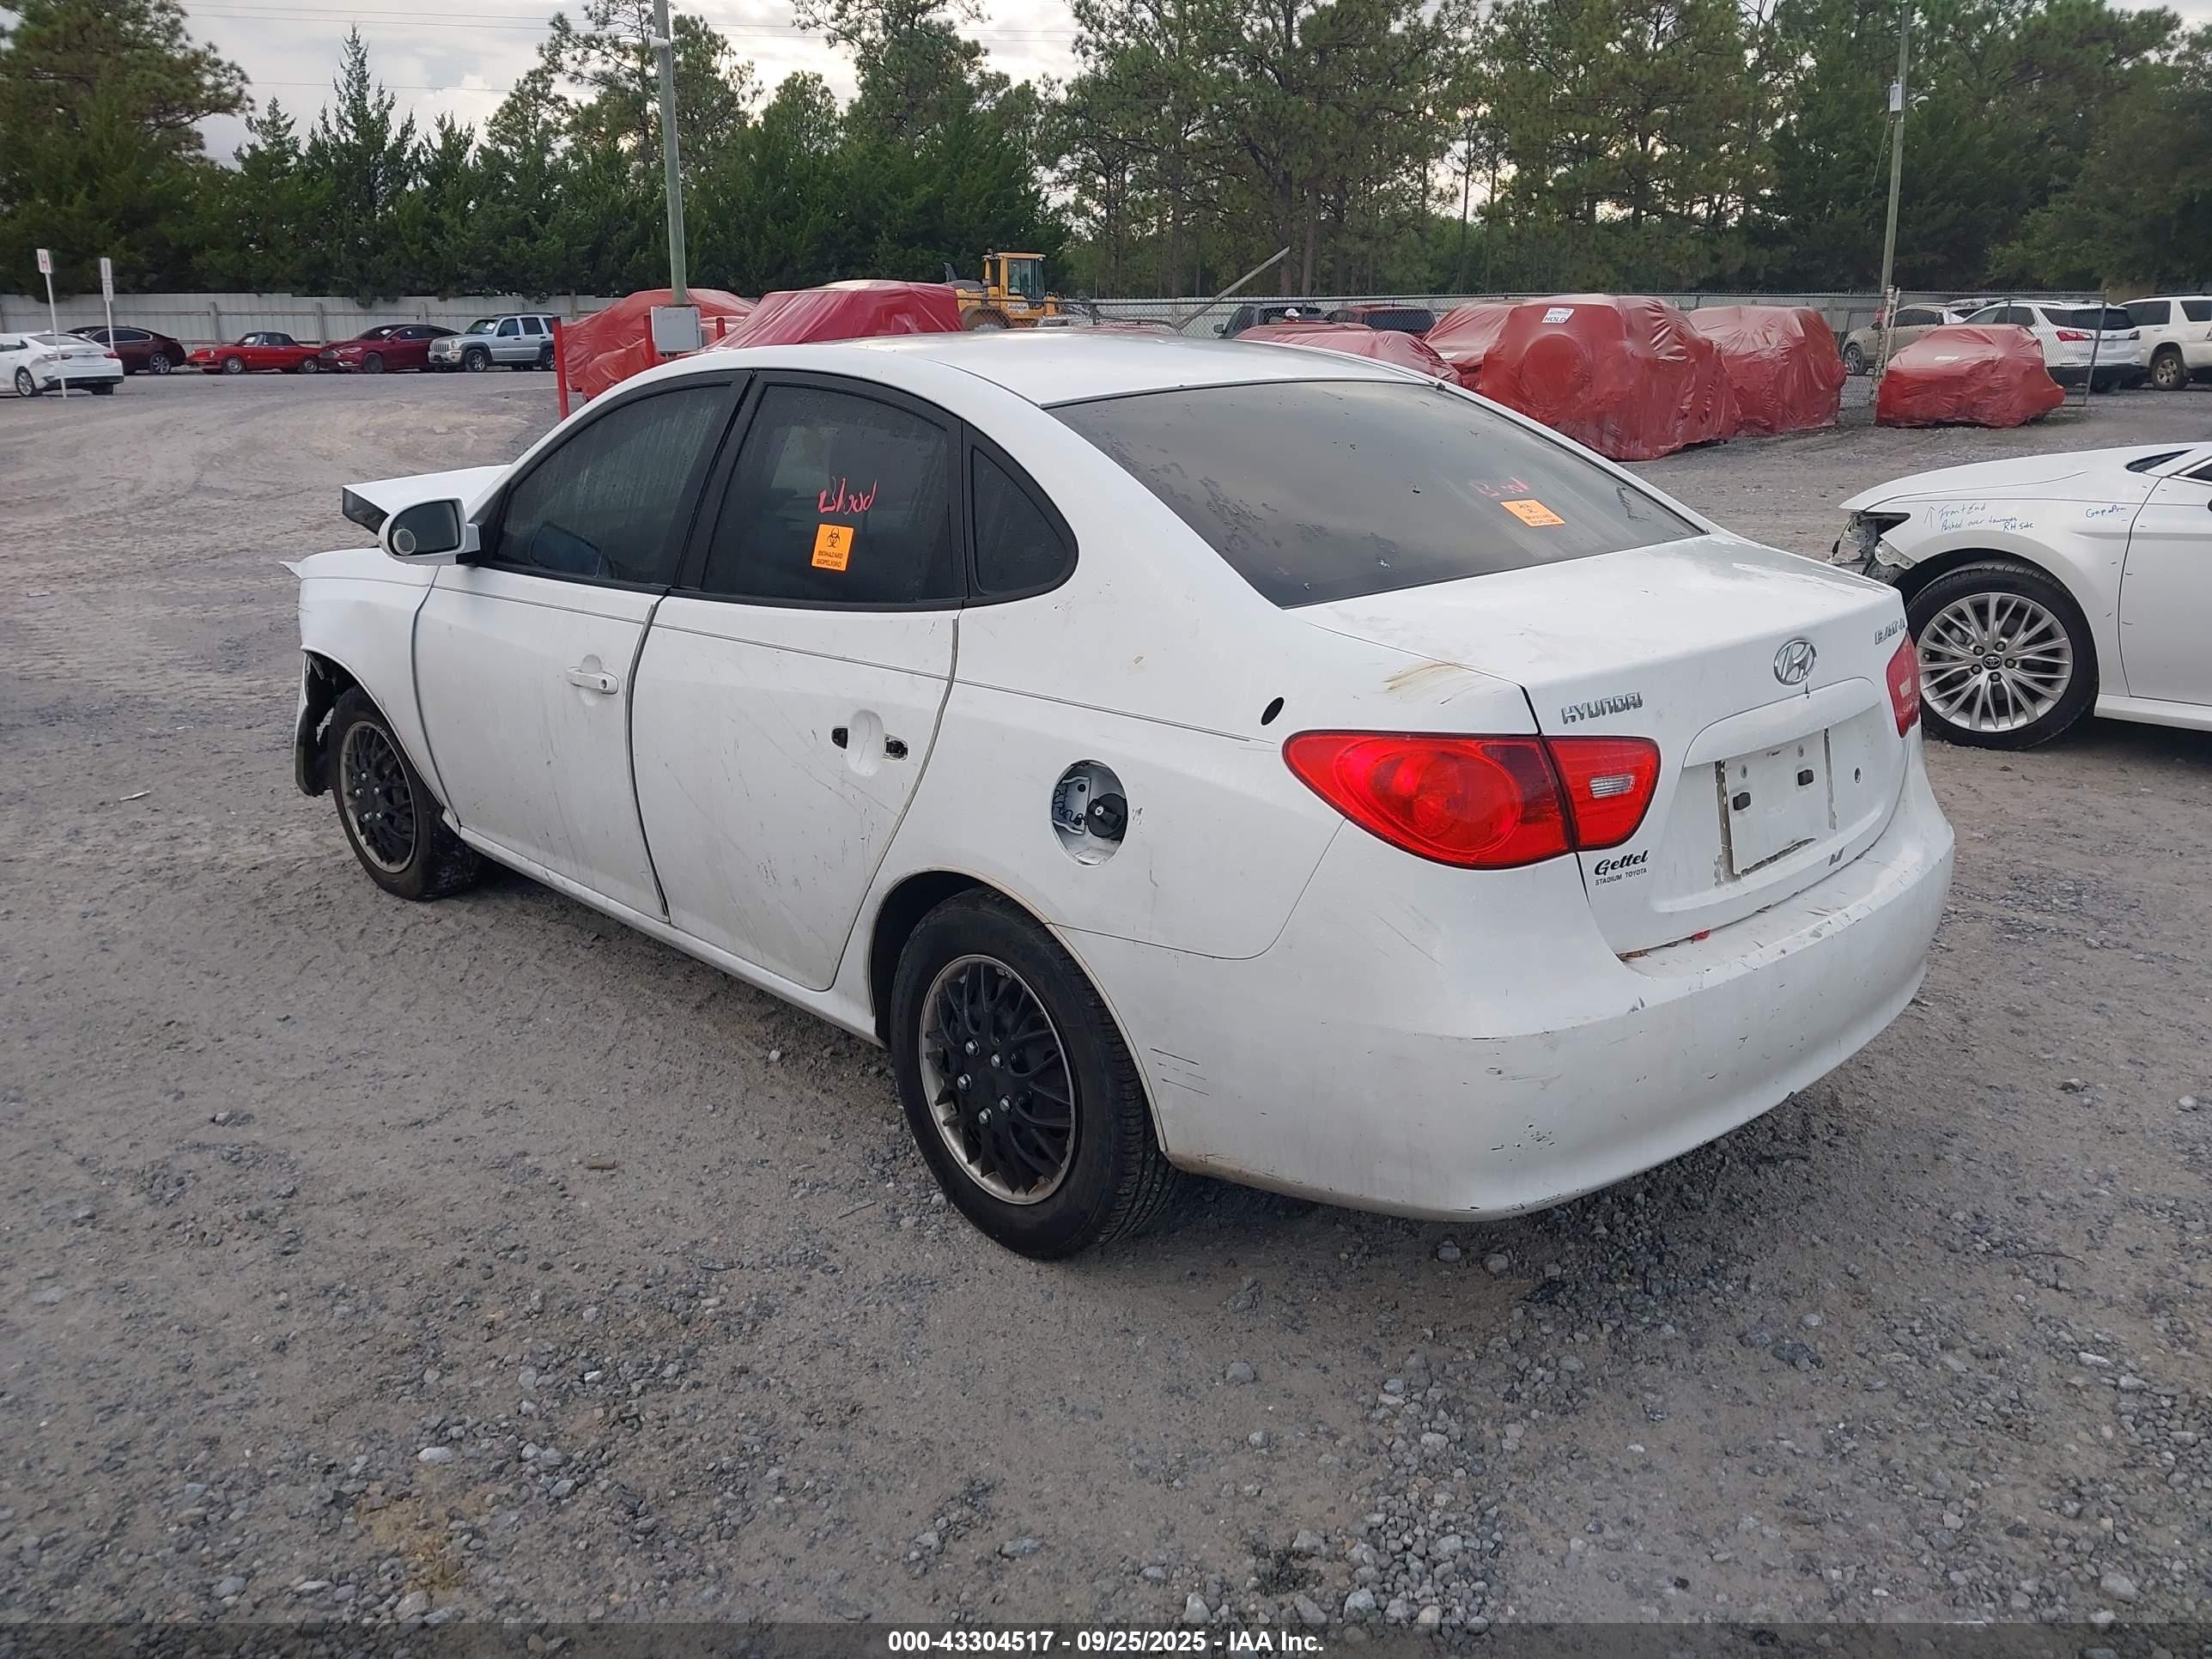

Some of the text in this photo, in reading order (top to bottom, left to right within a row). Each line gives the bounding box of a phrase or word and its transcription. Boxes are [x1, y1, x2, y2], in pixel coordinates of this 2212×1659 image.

[1561, 690, 1643, 725] HYUNDAI
[1595, 850, 1649, 876] Gettel
[1595, 867, 1648, 886] STADIUM TOYOTA
